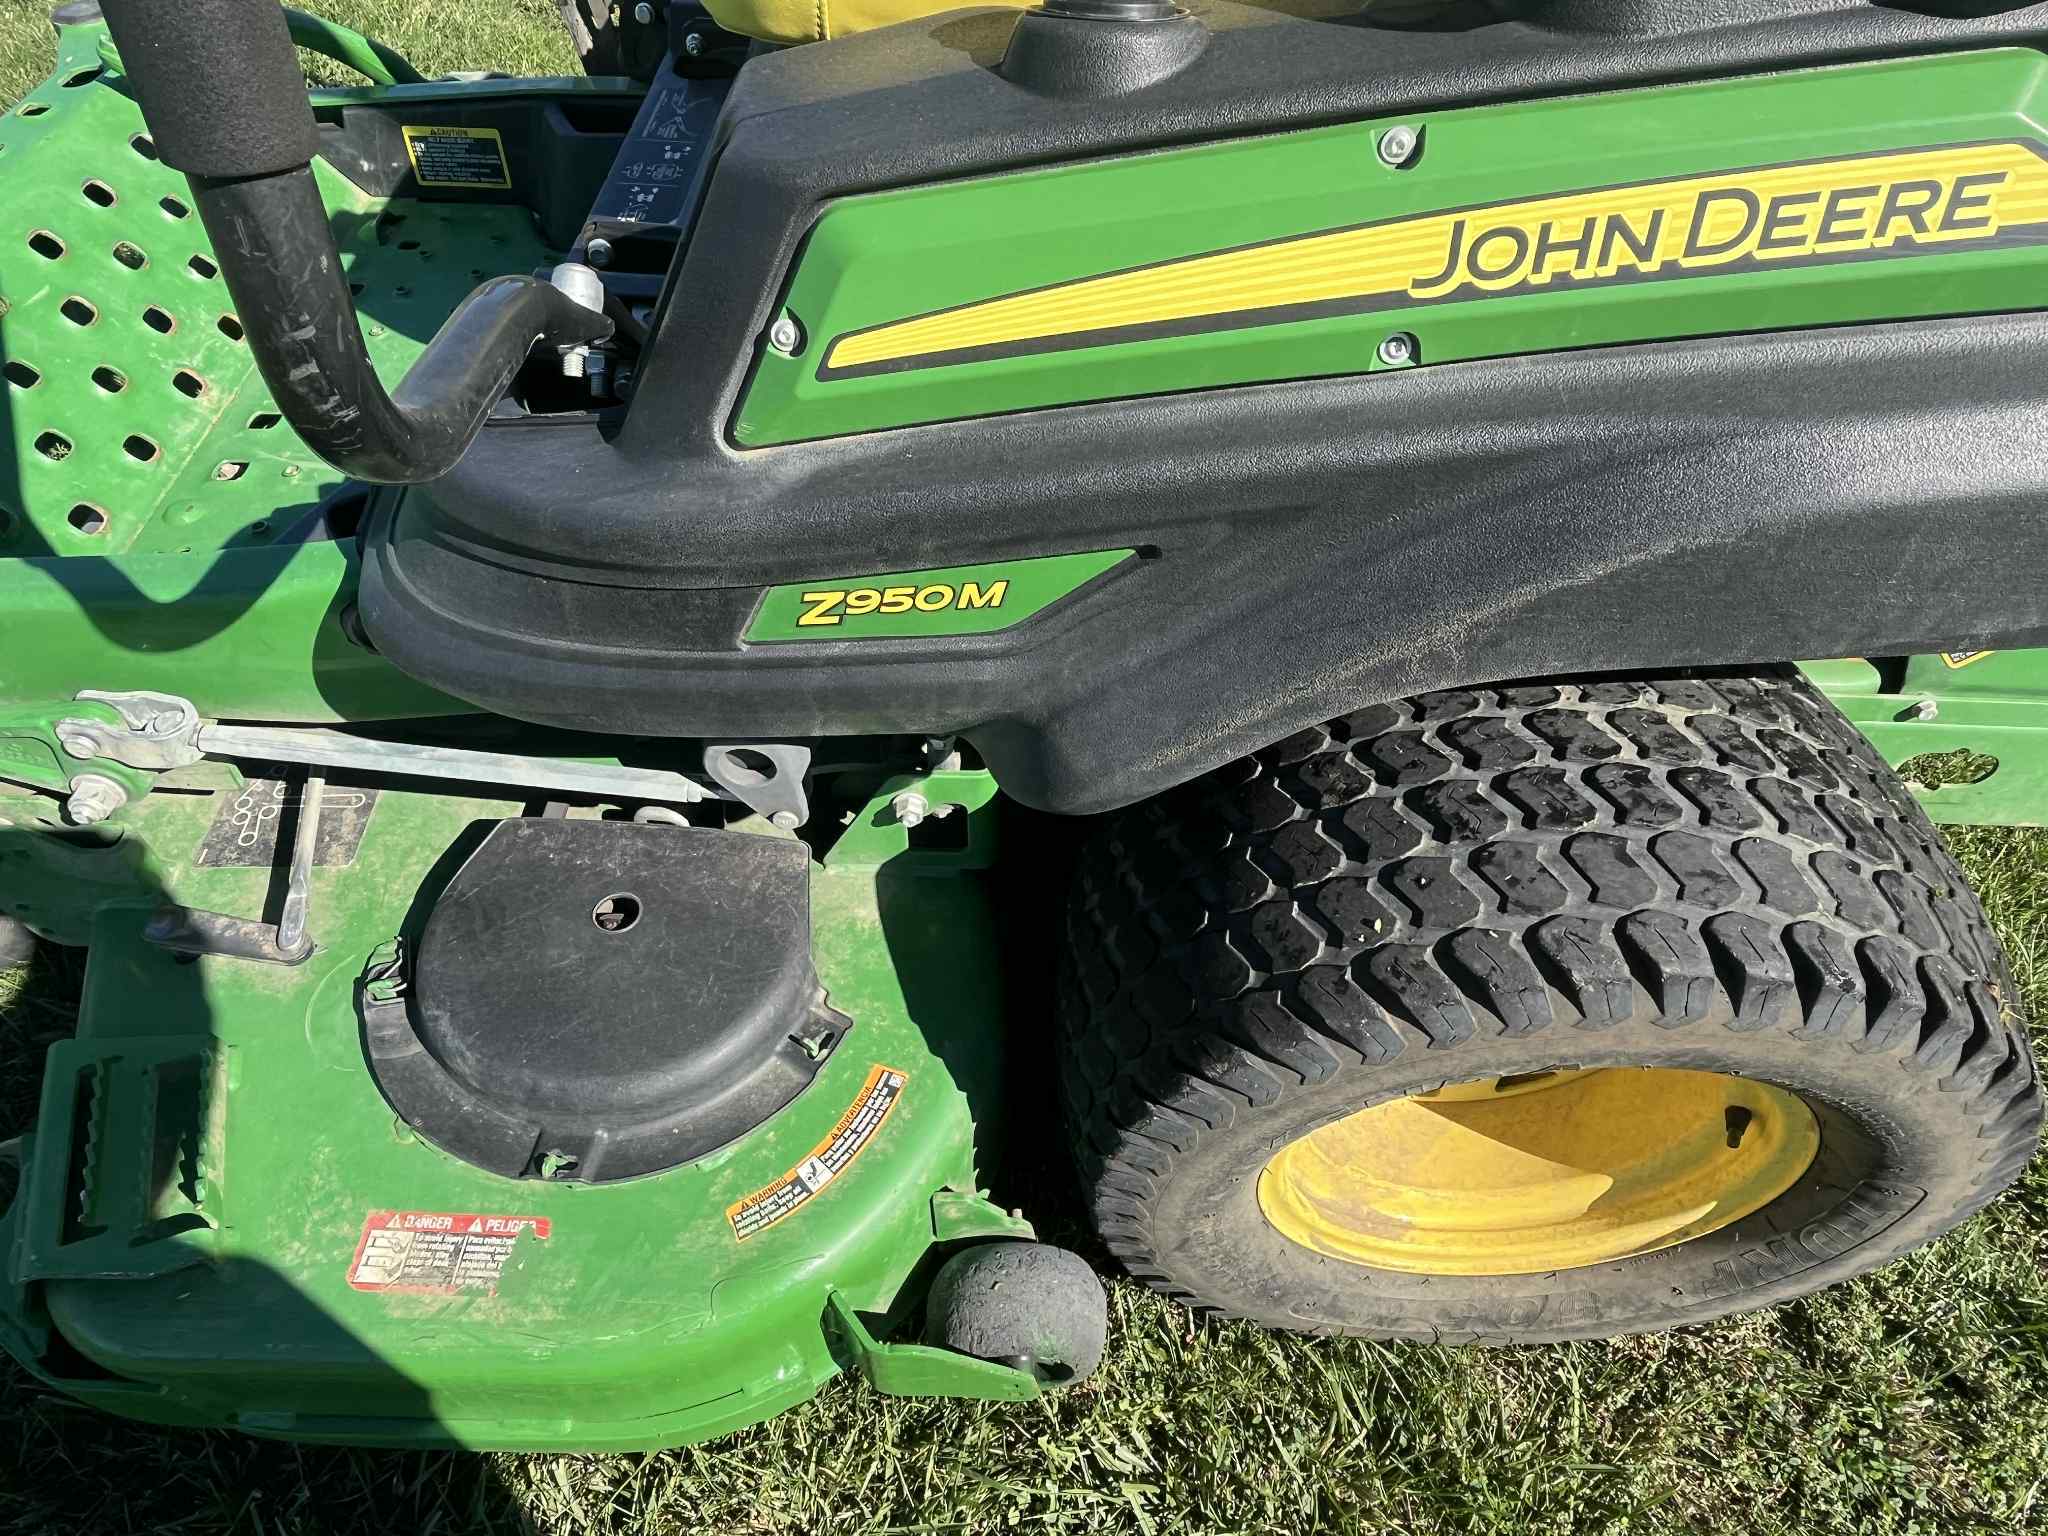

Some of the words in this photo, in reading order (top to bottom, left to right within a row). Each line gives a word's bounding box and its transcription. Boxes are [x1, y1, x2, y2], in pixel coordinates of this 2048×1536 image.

[1410, 209, 1665, 291] JOHN
[1682, 171, 2008, 259] DEERE
[750, 1178, 788, 1206] WARNING
[404, 1215, 453, 1230] DANGER
